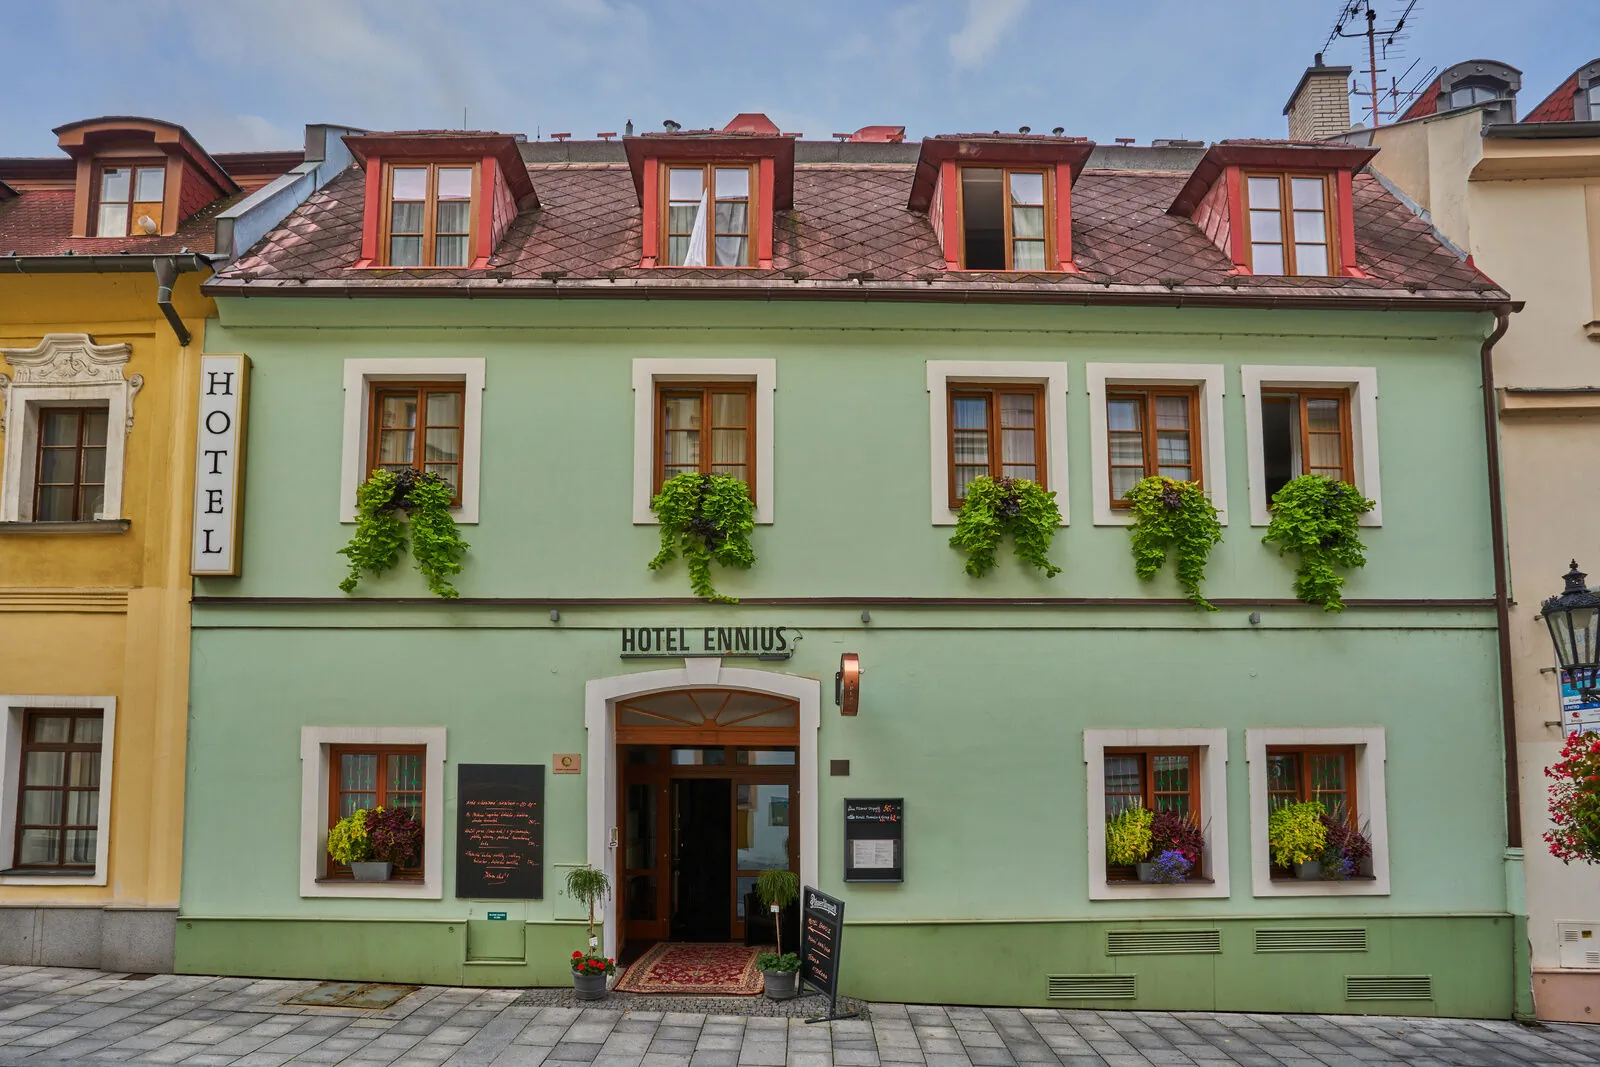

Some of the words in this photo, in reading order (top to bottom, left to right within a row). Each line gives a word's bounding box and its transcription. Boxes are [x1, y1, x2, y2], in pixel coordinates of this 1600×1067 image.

[202, 371, 234, 554] HOTEL
[621, 627, 690, 652] HOTEL
[703, 626, 788, 652] ENNIUS
